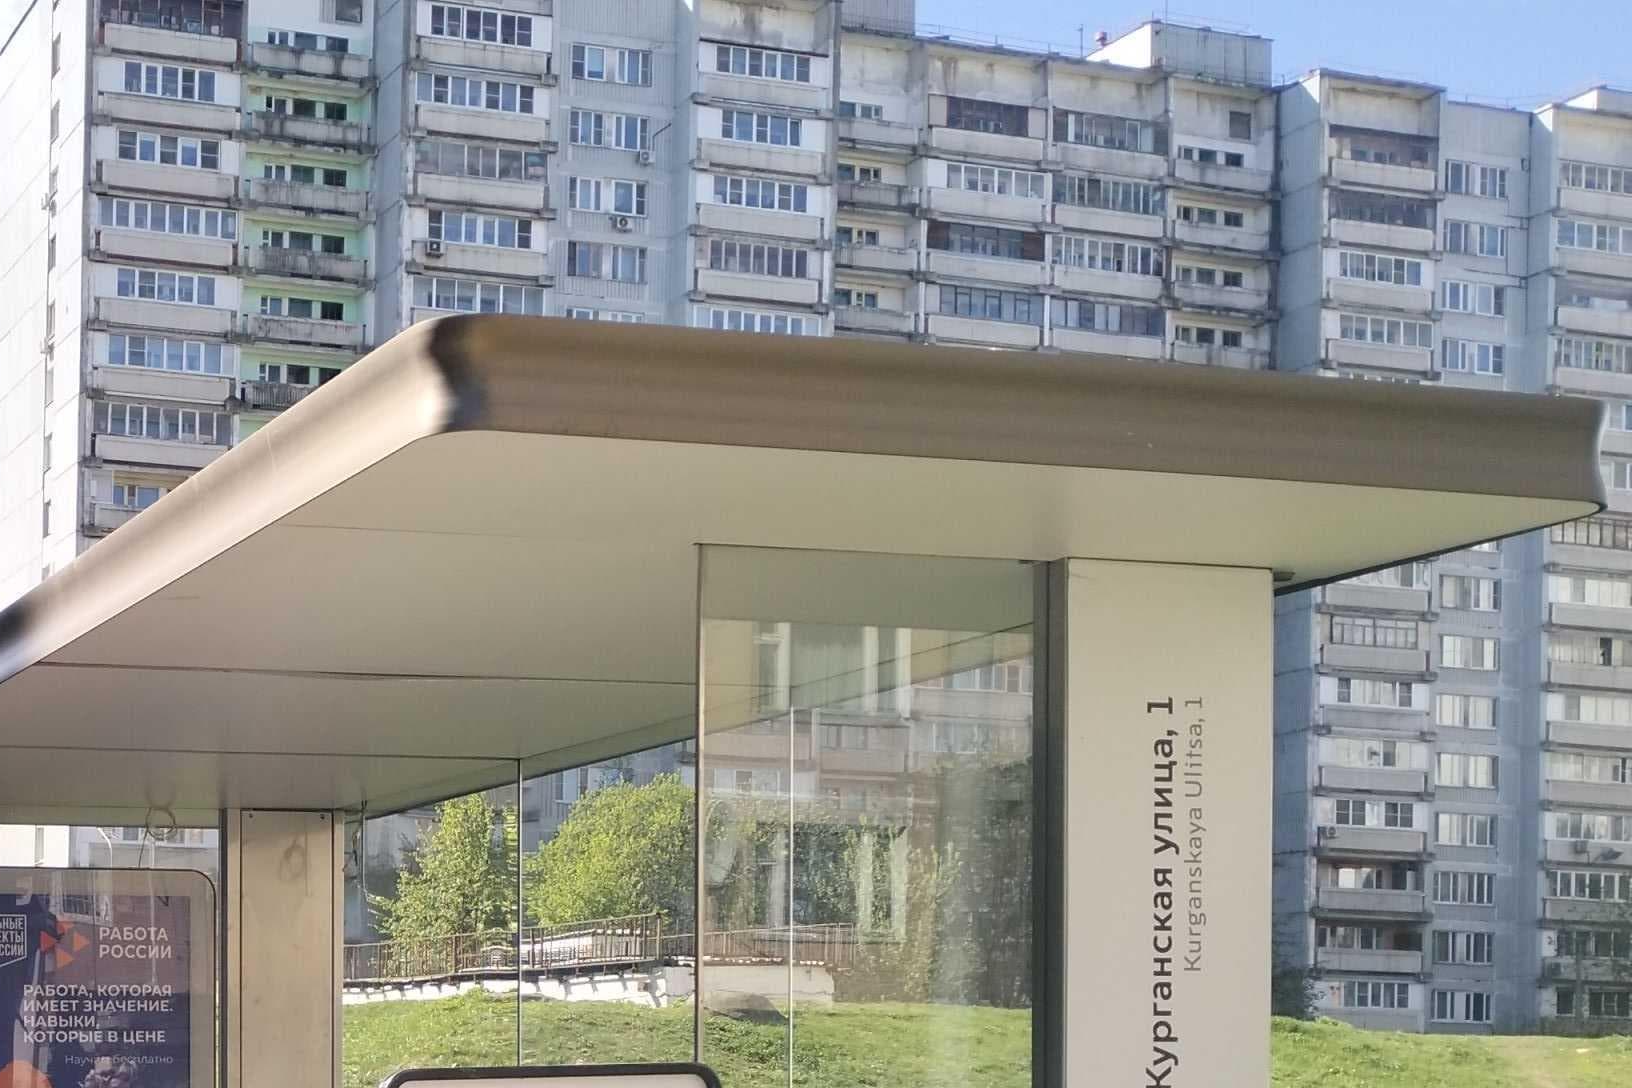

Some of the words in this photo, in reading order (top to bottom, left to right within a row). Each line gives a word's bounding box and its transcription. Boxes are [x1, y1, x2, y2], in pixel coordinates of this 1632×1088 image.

[1147, 696, 1174, 715] 1
[1184, 696, 1203, 709] 1
[1184, 718, 1206, 798] Ulitsa,
[1152, 730, 1180, 855] улица,
[1184, 806, 1207, 973] Kurganskaya
[99, 927, 169, 942] РАБОТА
[99, 944, 172, 959] РОССИИ
[23, 984, 94, 998] РАБОТА,
[97, 984, 172, 997] КОТОРАЯ
[23, 1000, 79, 1012] ИМЕЕТ
[82, 999, 173, 1013] ЗНАЧЕНИЕ.
[23, 1015, 100, 1030] НАВЫКИ,
[23, 1030, 103, 1043] КОТОРЫЕ
[108, 1031, 118, 1043] В
[123, 1030, 166, 1045] ЦЕНЕ
